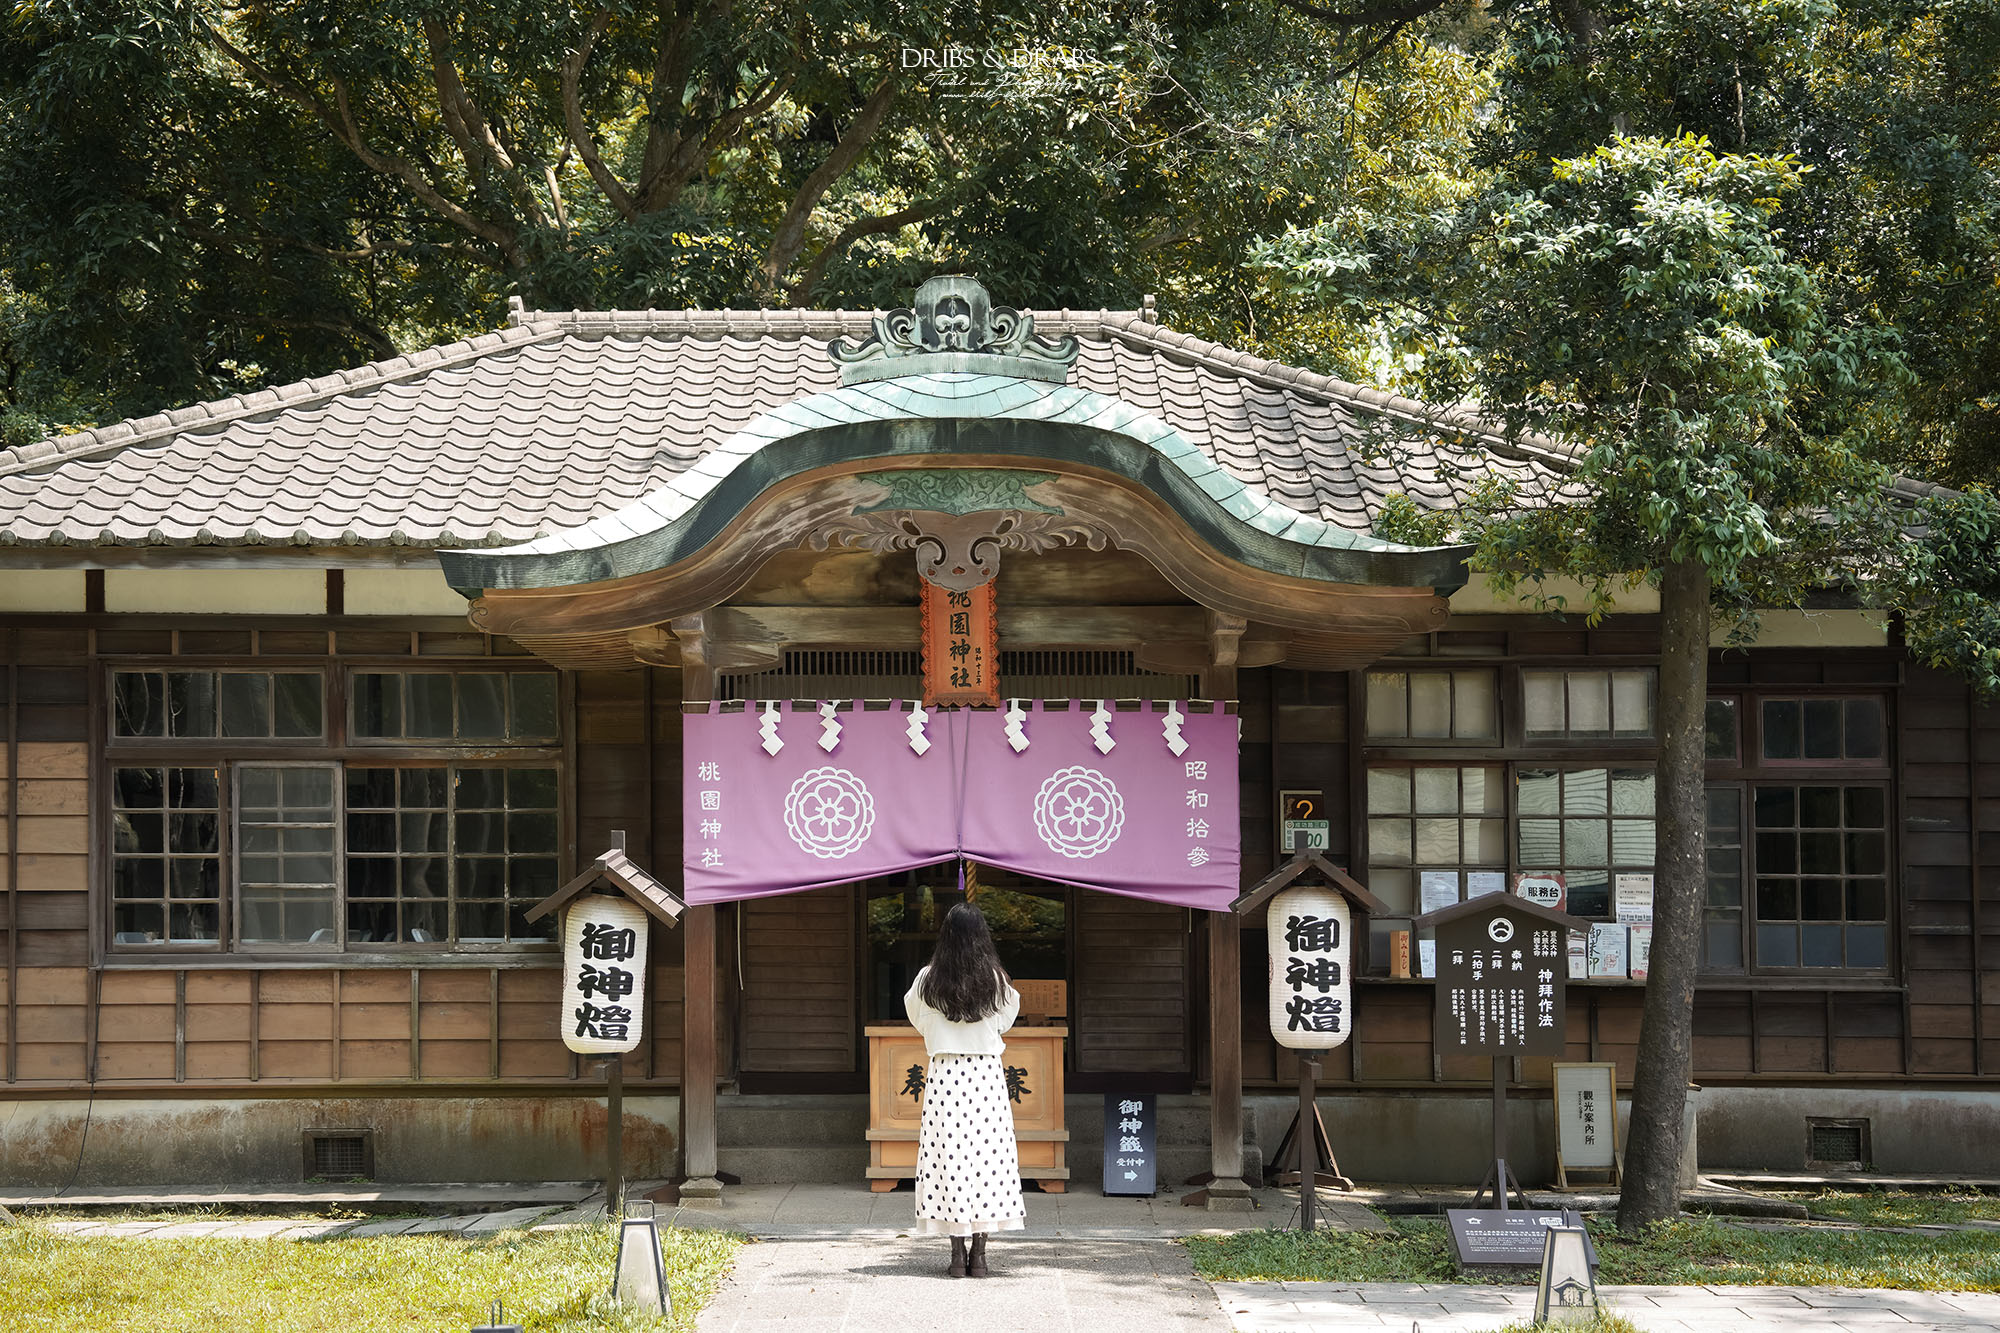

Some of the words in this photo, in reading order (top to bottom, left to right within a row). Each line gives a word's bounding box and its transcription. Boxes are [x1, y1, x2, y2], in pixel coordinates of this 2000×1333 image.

[947, 590, 972, 688] 桃園神社
[698, 761, 724, 868] 桃園神社
[1185, 760, 1210, 867] 昭和拾參
[1528, 887, 1559, 898] 服務台
[575, 922, 637, 1041] 御神燈
[1284, 915, 1342, 1033] 御神燈
[1452, 950, 1463, 965] 一拜
[1472, 950, 1483, 981] 二拍手
[1491, 950, 1502, 969] 二拜
[1538, 968, 1553, 1027] 神拜作法
[900, 1063, 926, 1103] 奉
[1118, 1099, 1144, 1153] 御神籤
[1583, 1090, 1595, 1145] 觀光案內所
[1116, 1157, 1145, 1167] 受付中
